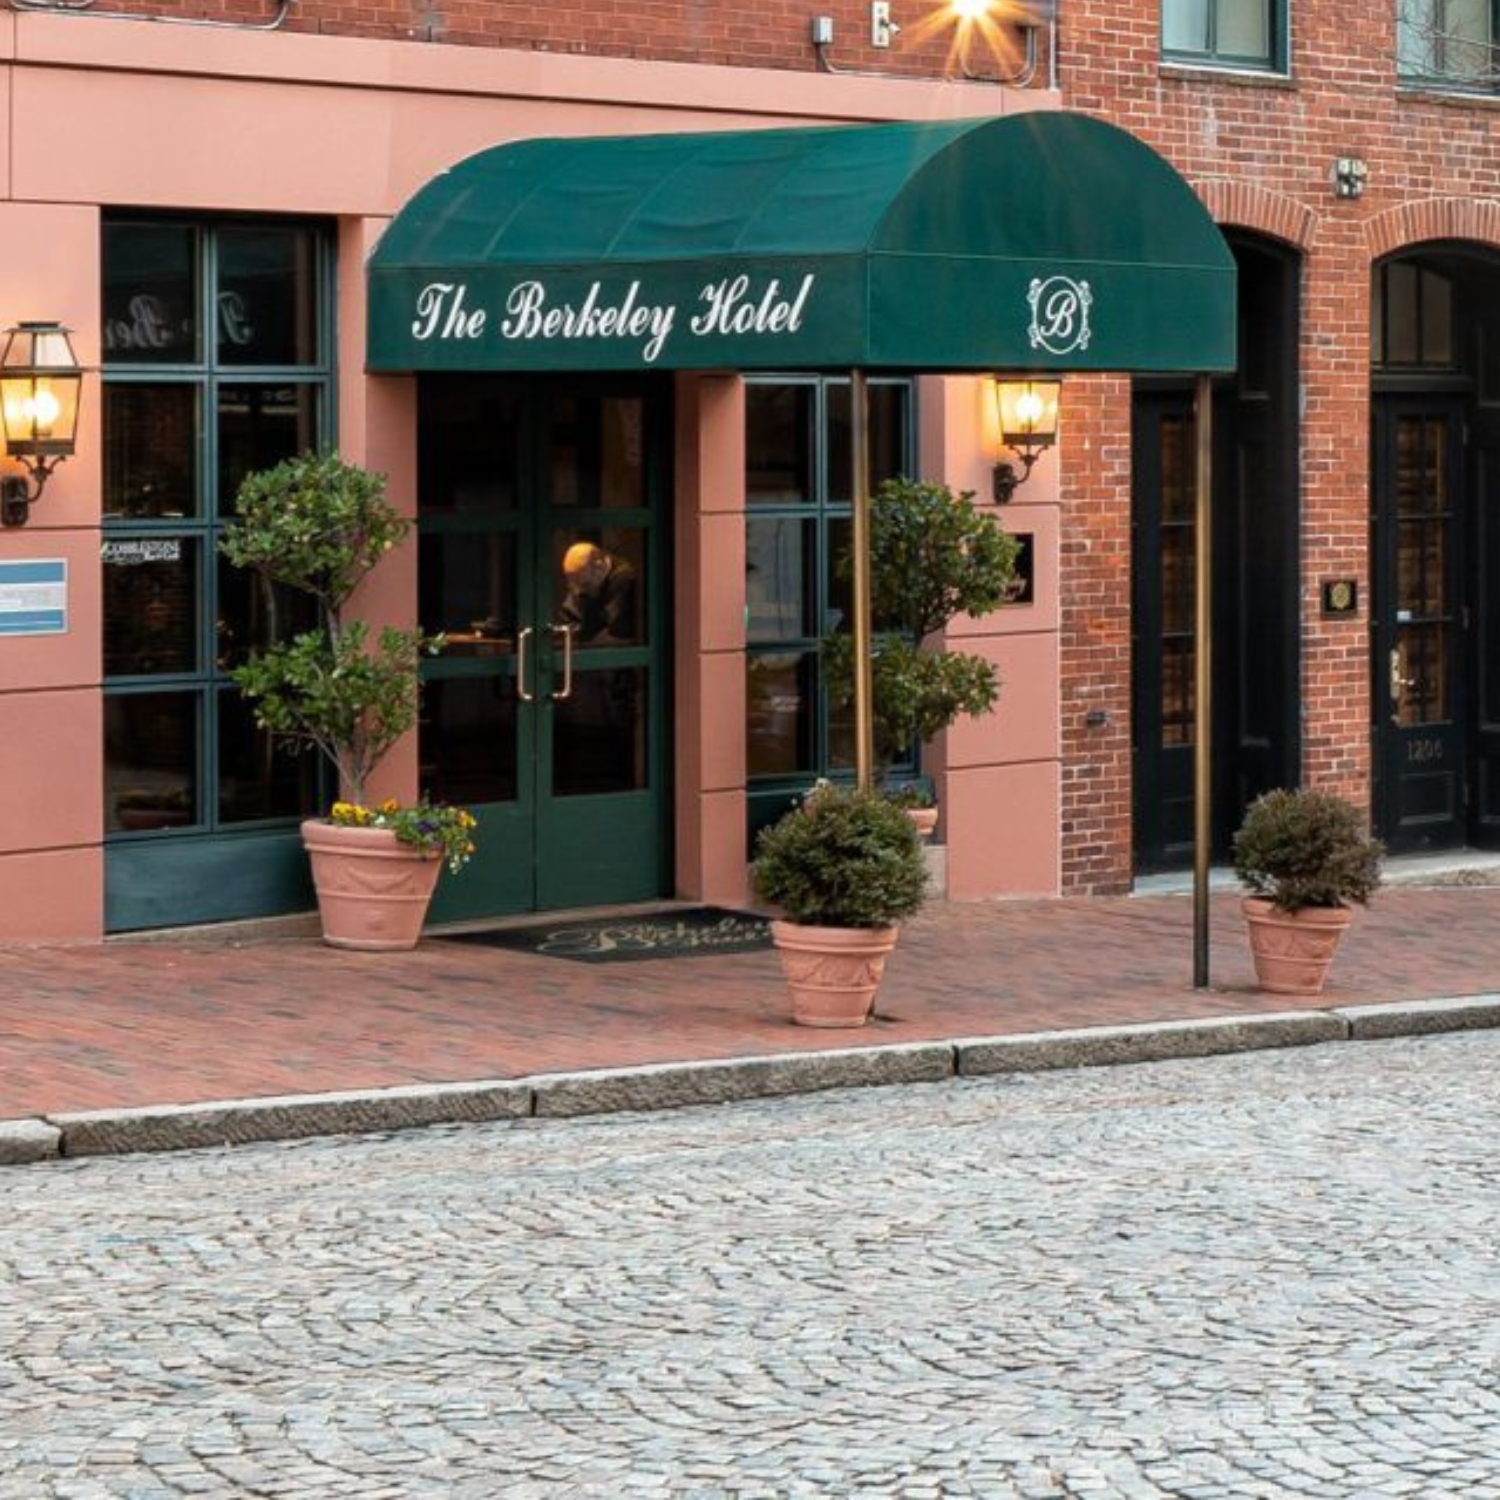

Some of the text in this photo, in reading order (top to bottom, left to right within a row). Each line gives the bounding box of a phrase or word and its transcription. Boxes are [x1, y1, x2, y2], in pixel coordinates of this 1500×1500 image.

[411, 273, 815, 363] The Berkeley Hotel
